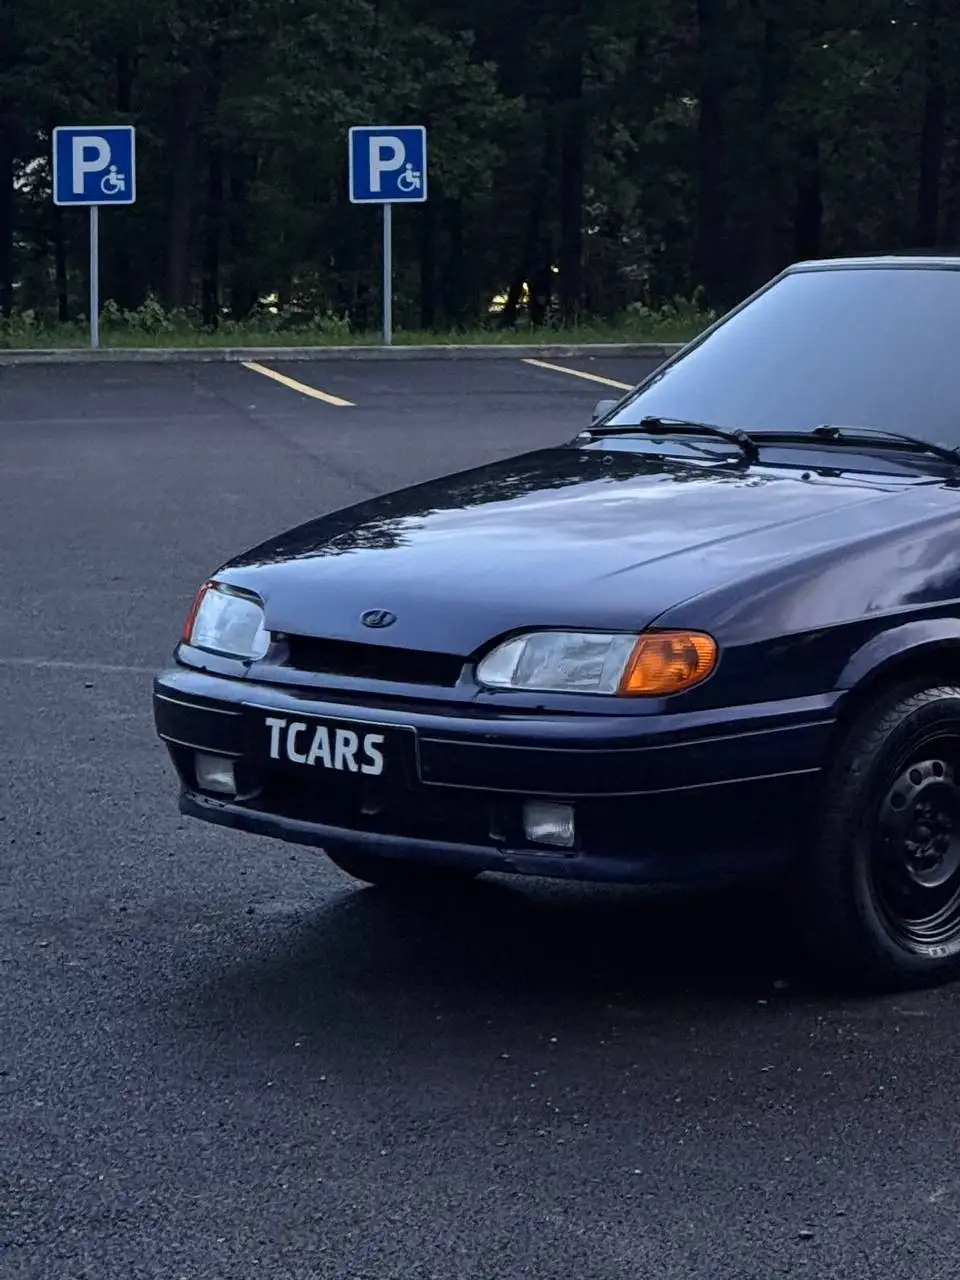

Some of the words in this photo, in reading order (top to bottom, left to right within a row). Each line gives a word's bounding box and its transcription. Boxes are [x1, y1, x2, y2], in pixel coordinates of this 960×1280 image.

[72, 136, 111, 194] P
[369, 136, 406, 192] P
[265, 717, 385, 776] TCARS
